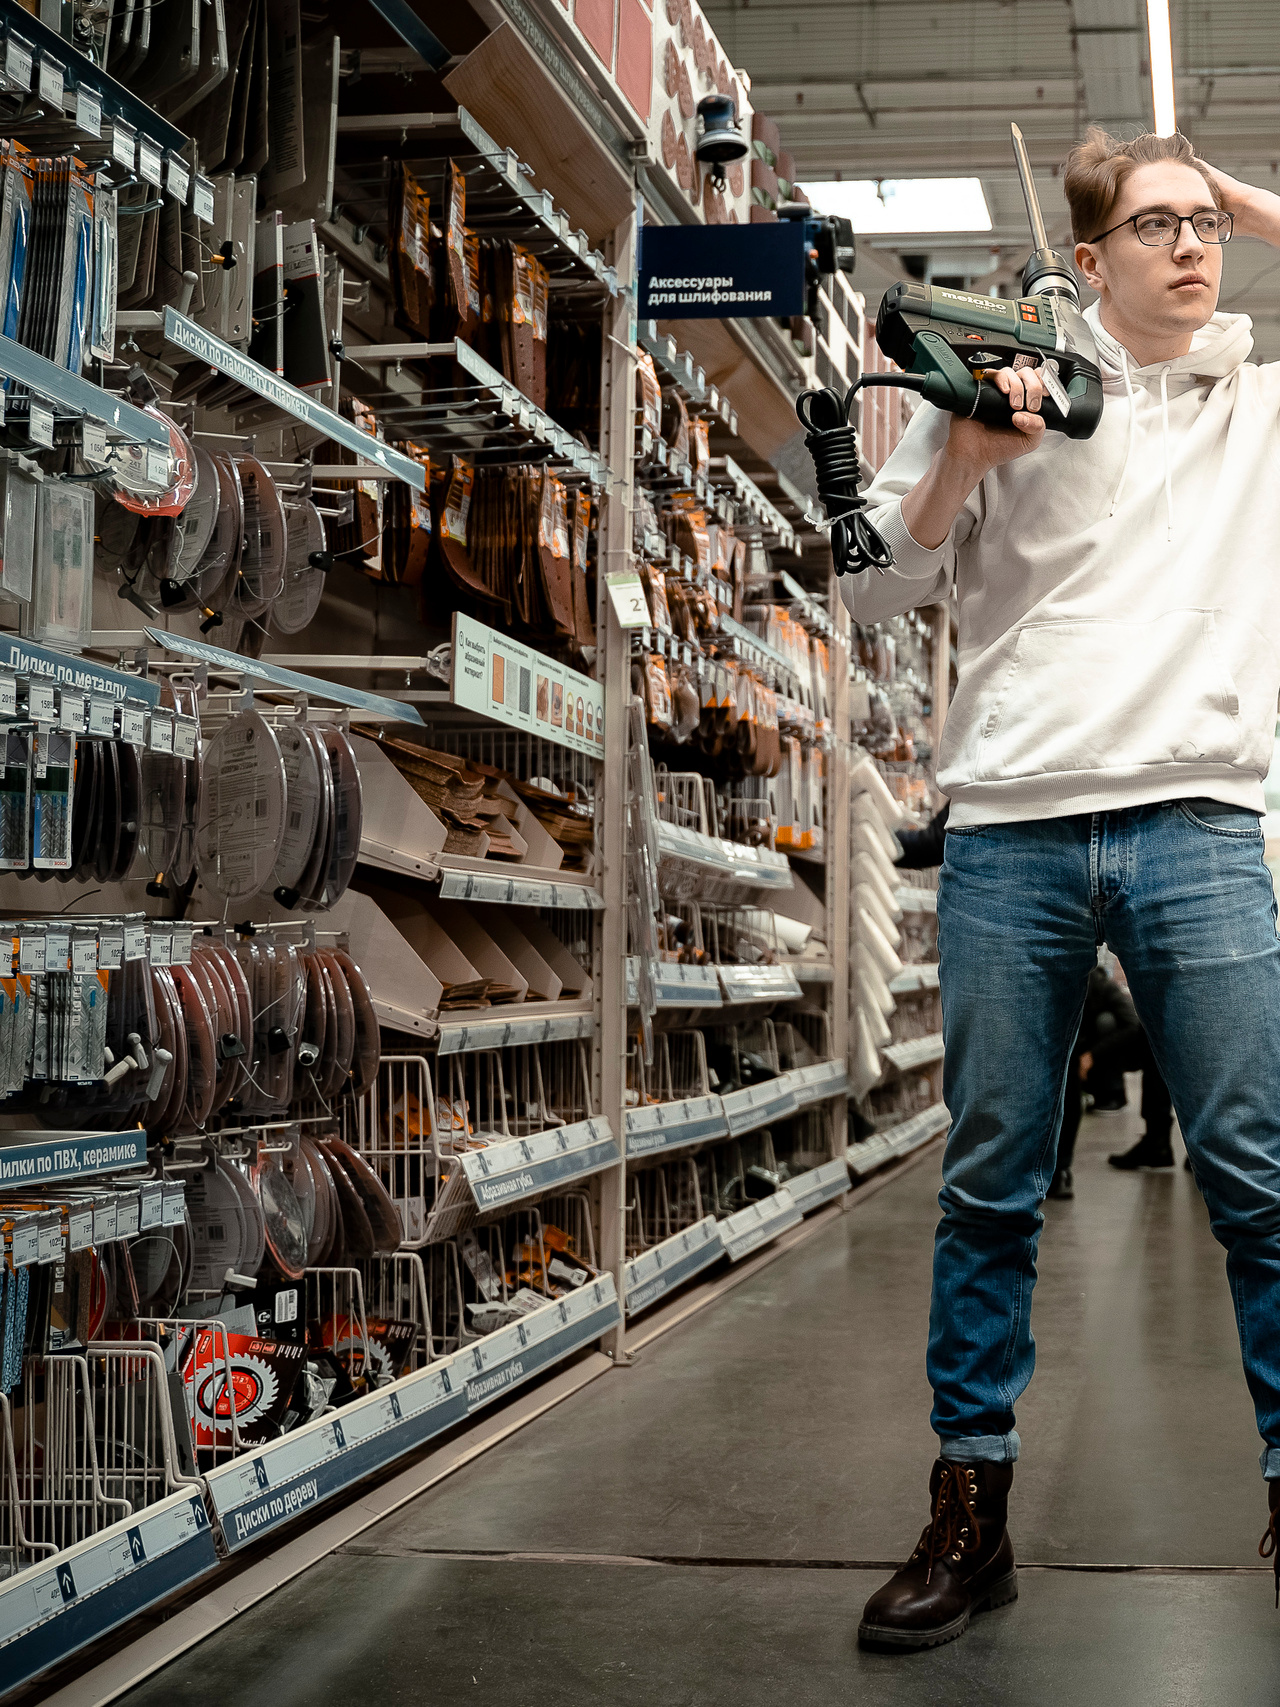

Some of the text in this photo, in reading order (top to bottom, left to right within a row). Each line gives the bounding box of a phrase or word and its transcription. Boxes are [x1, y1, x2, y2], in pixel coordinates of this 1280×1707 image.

[647, 289, 773, 307] для шлифования
[649, 276, 734, 291] Аксессуары
[941, 290, 1008, 311] metabo
[173, 319, 207, 354] Диски
[209, 343, 221, 362] по
[222, 354, 269, 395] ламинату
[276, 388, 310, 420] паркету
[10, 645, 128, 699] Пилки по металлу
[37, 1155, 52, 1174] по
[53, 1148, 82, 1171] ПВХ,
[83, 1143, 137, 1168] керамике
[480, 1171, 534, 1202] Абразивная губка
[467, 1359, 524, 1401] Абразивная губка
[235, 1478, 318, 1540] Диски по дереву
